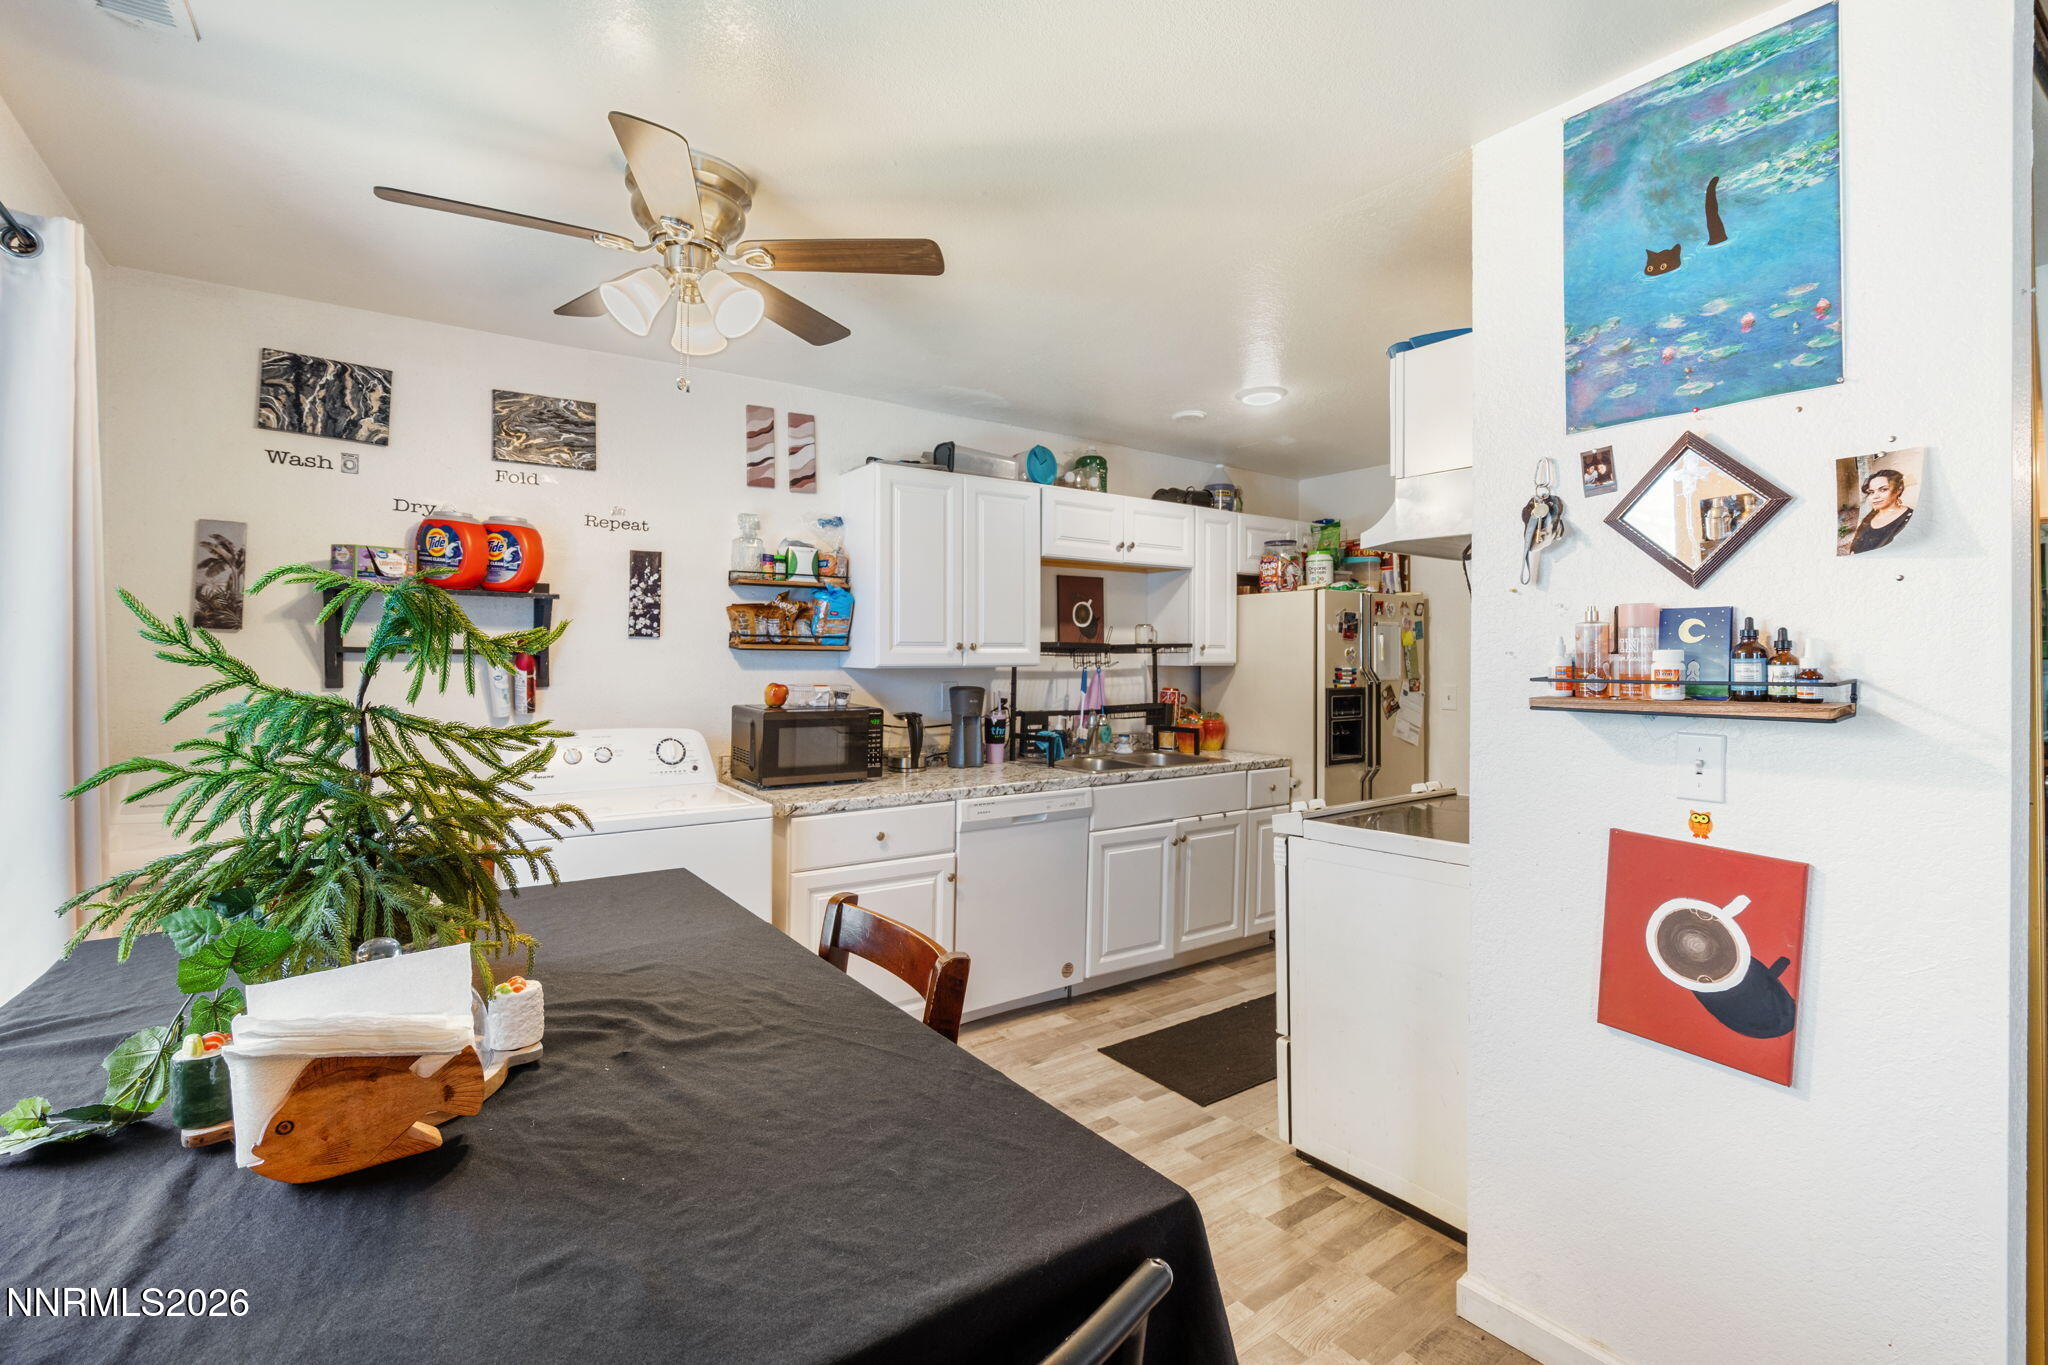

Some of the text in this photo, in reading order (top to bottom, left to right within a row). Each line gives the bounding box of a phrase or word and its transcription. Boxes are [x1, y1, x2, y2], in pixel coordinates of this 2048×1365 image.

[264, 449, 334, 470] Wash
[495, 469, 540, 486] Fold
[392, 498, 437, 517] Dry
[584, 514, 650, 532] Repeat
[428, 535, 446, 550] Tide
[488, 540, 505, 553] Tide
